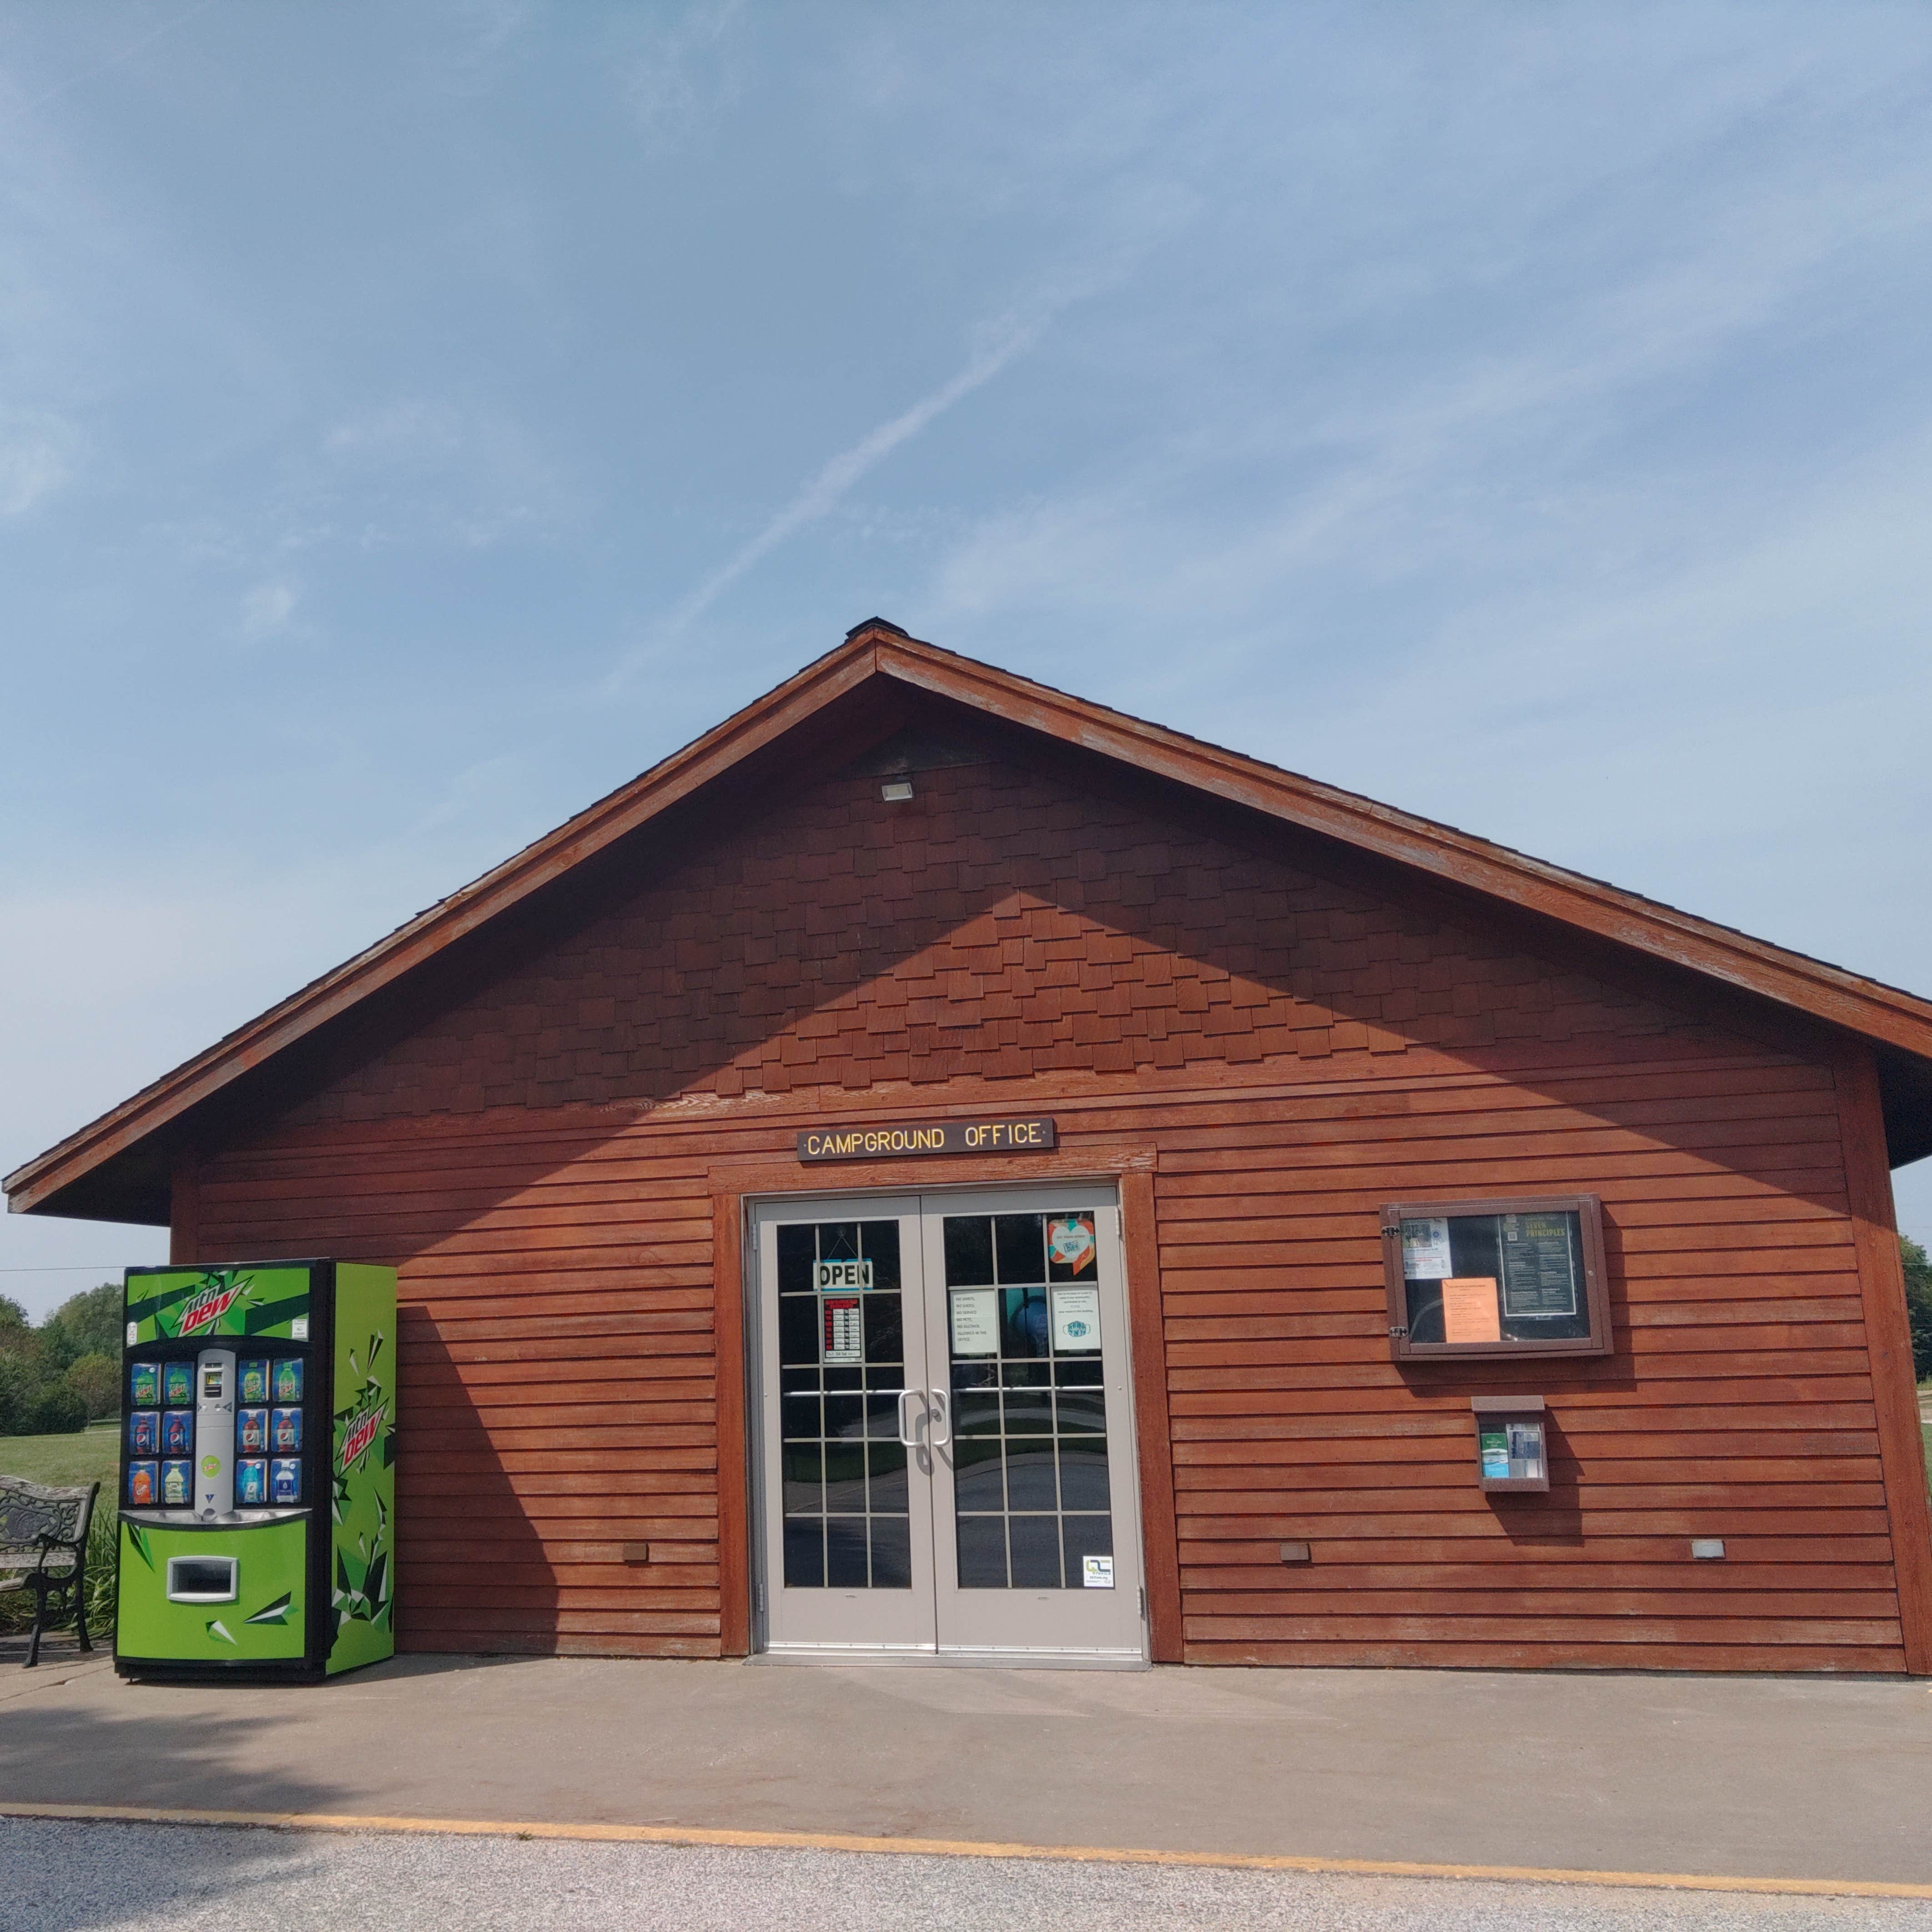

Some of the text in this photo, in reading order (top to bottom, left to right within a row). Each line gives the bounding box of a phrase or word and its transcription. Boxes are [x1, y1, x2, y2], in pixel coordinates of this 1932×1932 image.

[808, 1123, 1041, 1154] CAMPGROUND OFFICE
[1526, 1221, 1546, 1229] SEVEN
[1526, 1228, 1565, 1237] PRINCIPLES
[820, 1265, 869, 1285] OPEN
